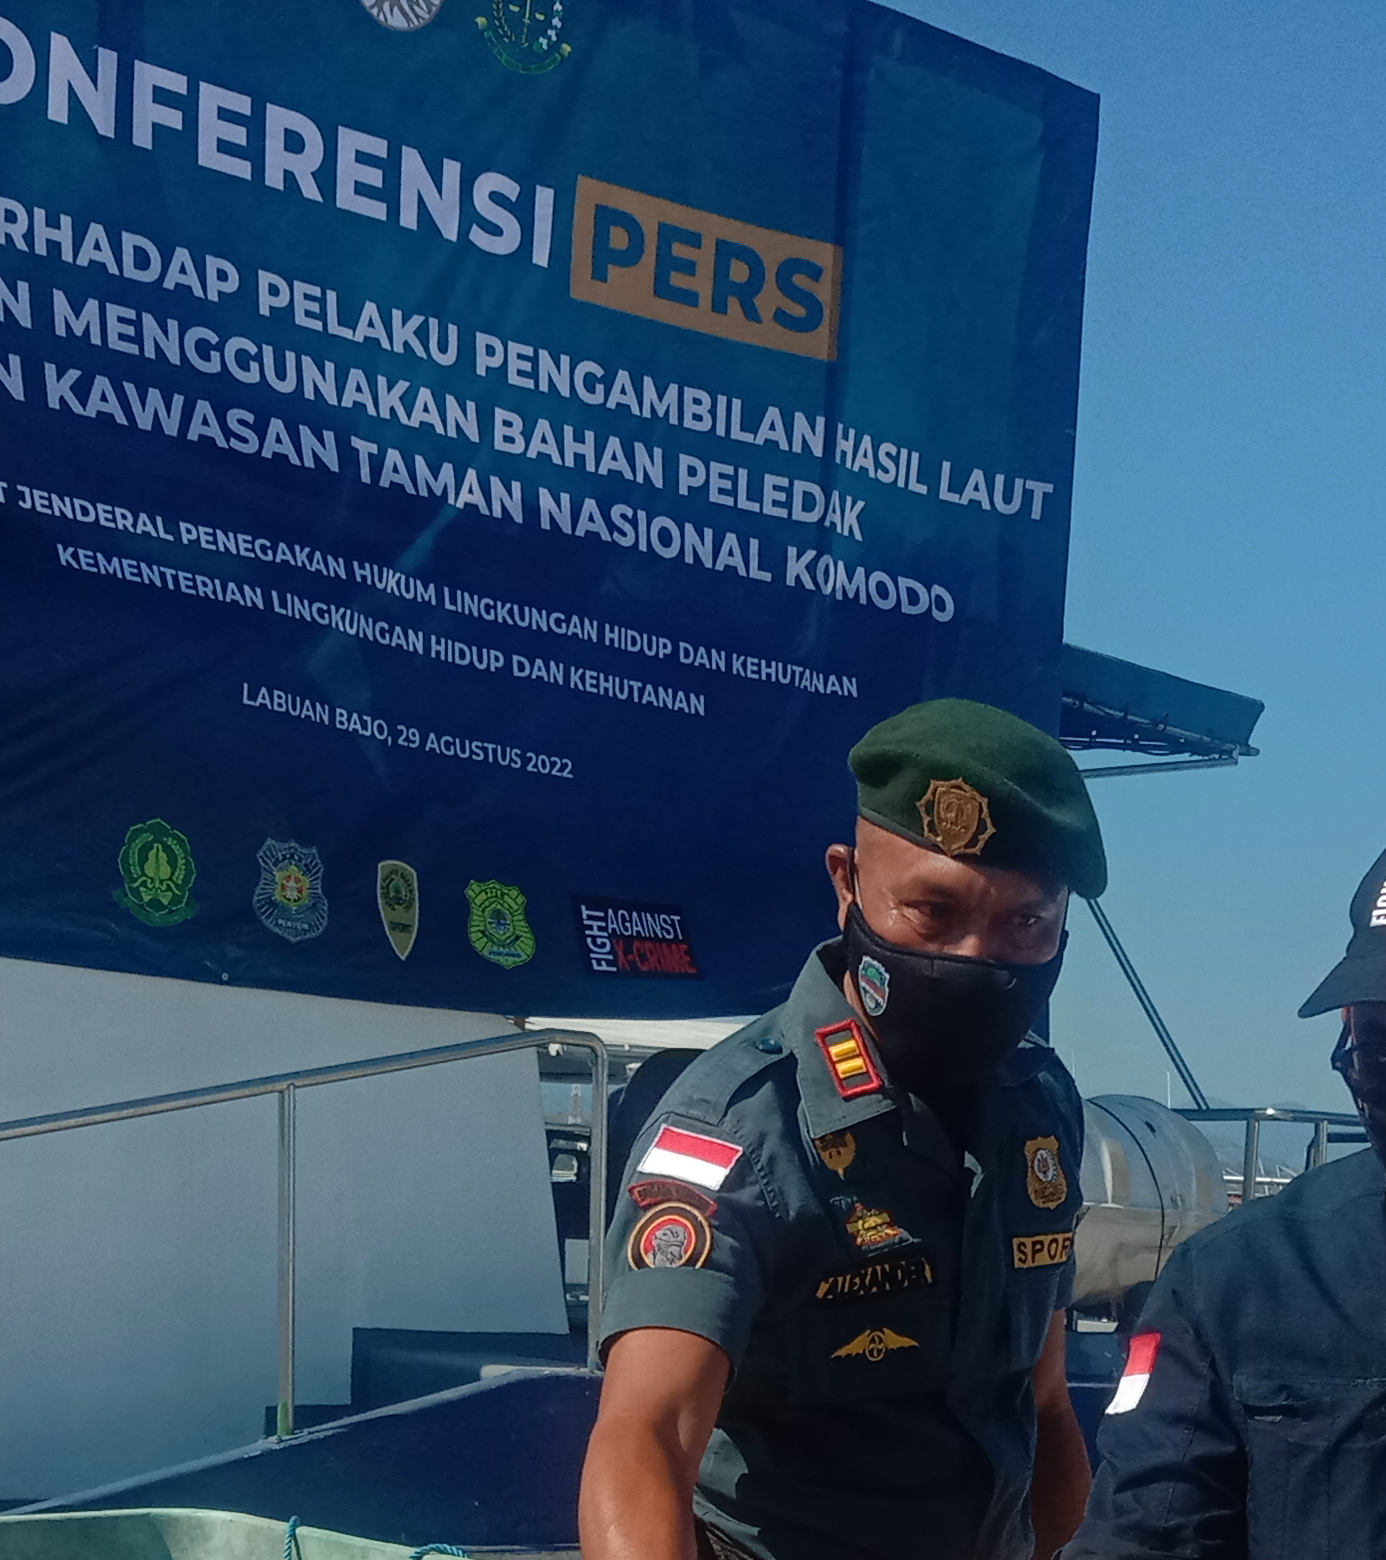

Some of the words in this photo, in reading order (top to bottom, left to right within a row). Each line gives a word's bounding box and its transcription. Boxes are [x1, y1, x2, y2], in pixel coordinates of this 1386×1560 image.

[590, 203, 826, 334] PERS
[53, 288, 479, 442] MENGGUNAKAN
[494, 407, 663, 488] BAHAN
[679, 454, 865, 541] PELEDAK
[258, 269, 458, 366] PELAKU
[476, 332, 825, 457] PENGAMBILAN
[836, 423, 928, 494] HASIL
[939, 461, 1053, 519] LAUT
[44, 362, 339, 472] KAWASAN
[351, 436, 523, 523] TAMAN
[539, 487, 772, 582] NASIONAL
[786, 546, 954, 622] KOMODO
[17, 485, 174, 541] JENDERAL
[179, 522, 346, 579] PENEGAKAN
[353, 561, 436, 605] HUKUM
[444, 587, 597, 642] LINGKUNGAN
[605, 624, 672, 658] HIDUP
[679, 642, 725, 671] DAN
[733, 654, 857, 697] KEHUTANAN
[57, 544, 264, 609] KEMENTERIAN
[272, 590, 423, 654] LINGKUNGAN
[431, 635, 504, 671] HIDUP
[512, 655, 563, 685] DAN
[570, 666, 704, 716] KEHUTANAN
[243, 683, 328, 724] LABUAN
[336, 708, 391, 745] BAJO,
[397, 725, 419, 747] 29
[426, 733, 521, 768] AGUSTUS
[527, 752, 573, 778] 2022
[580, 905, 617, 972] FIGHT
[607, 908, 683, 941] AGAINST
[613, 939, 698, 974] X-CRIME
